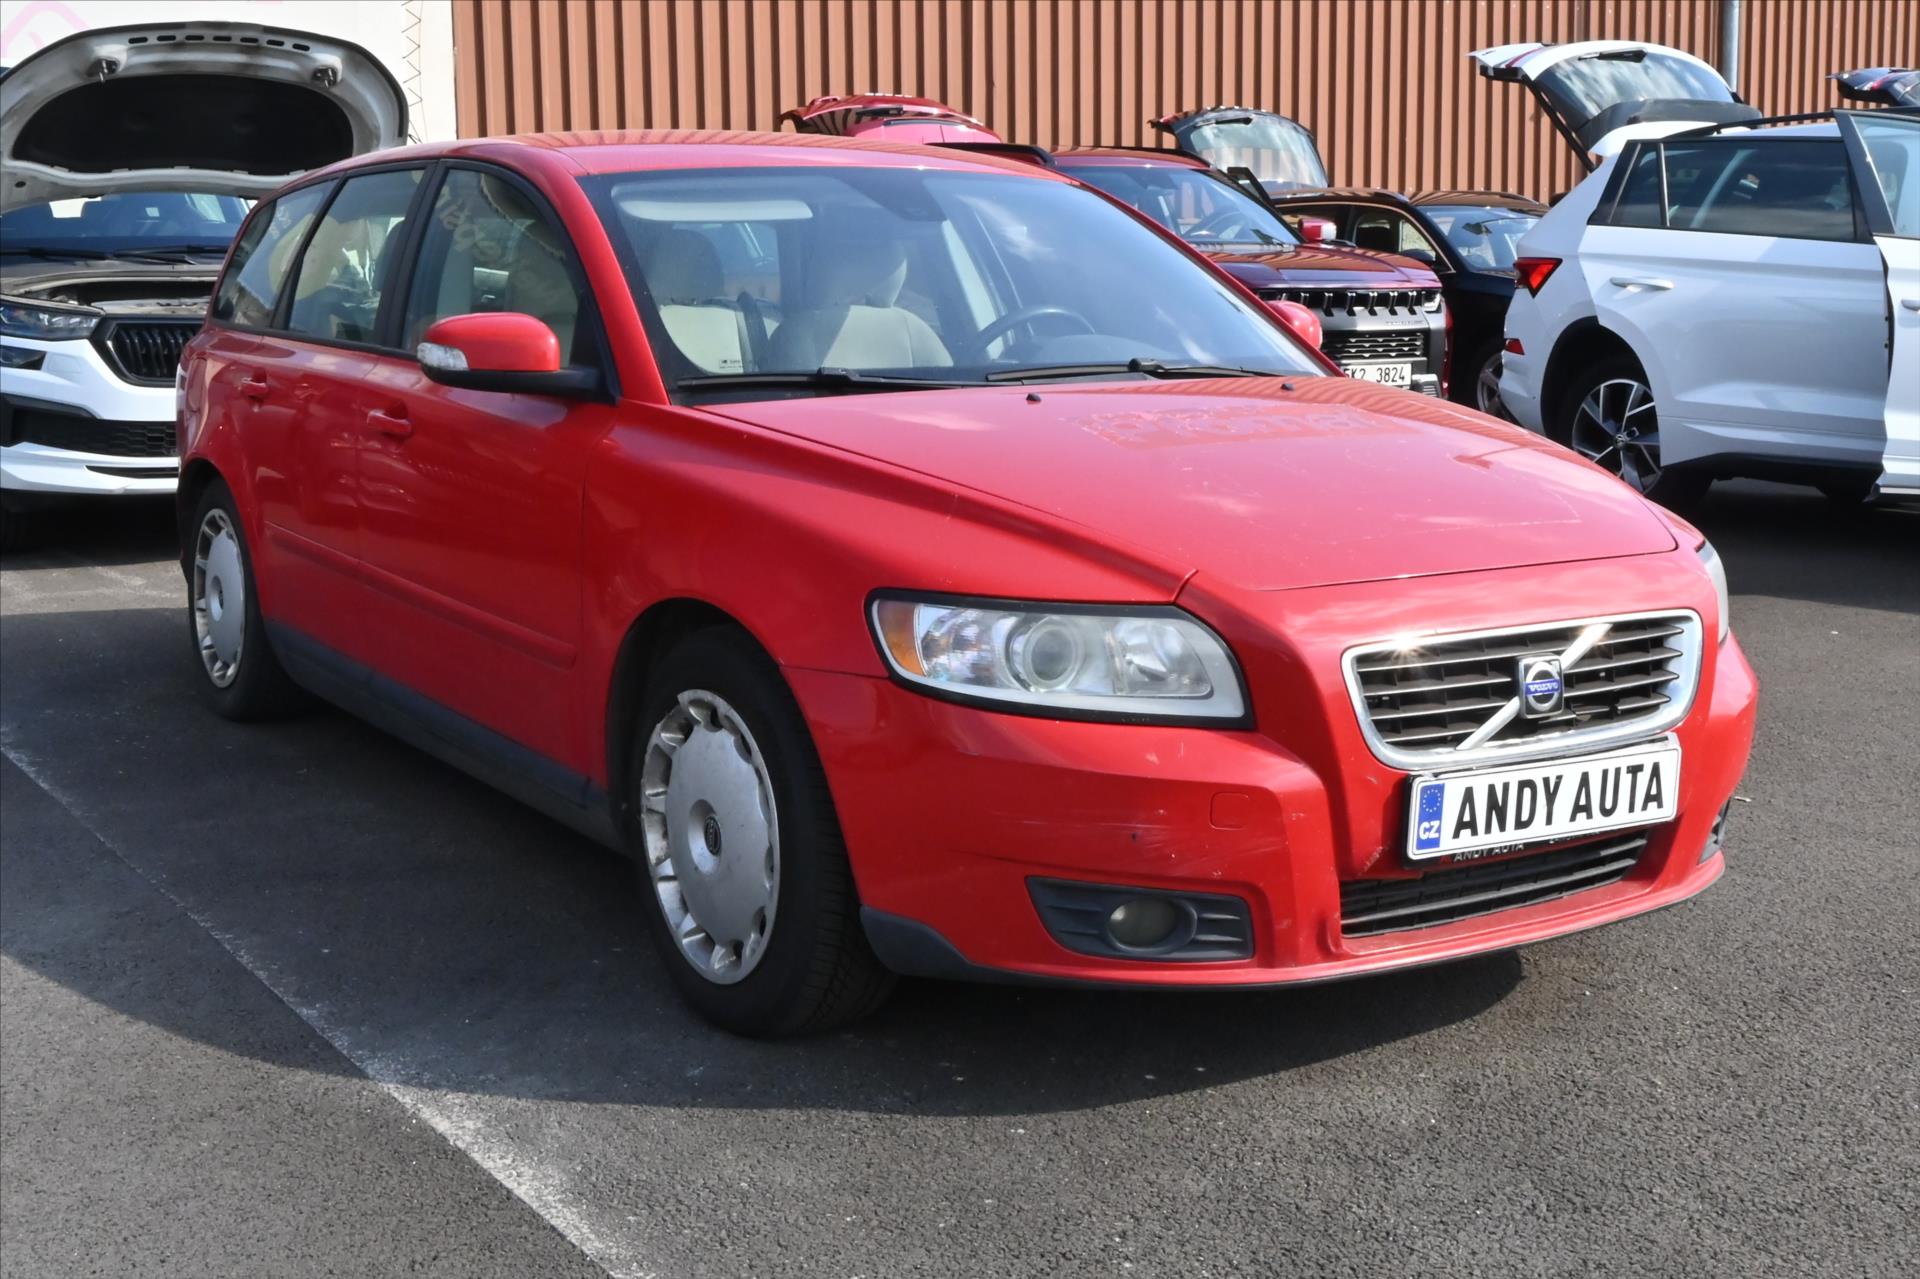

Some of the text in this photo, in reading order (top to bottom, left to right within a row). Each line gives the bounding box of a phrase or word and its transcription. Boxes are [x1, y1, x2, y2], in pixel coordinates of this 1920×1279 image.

[1376, 367, 1405, 382] 3824
[1528, 681, 1559, 692] VOLVO
[1452, 761, 1664, 839] ANDY AUTA
[1418, 819, 1440, 840] CZ
[1453, 844, 1524, 862] ANDY AUTA
